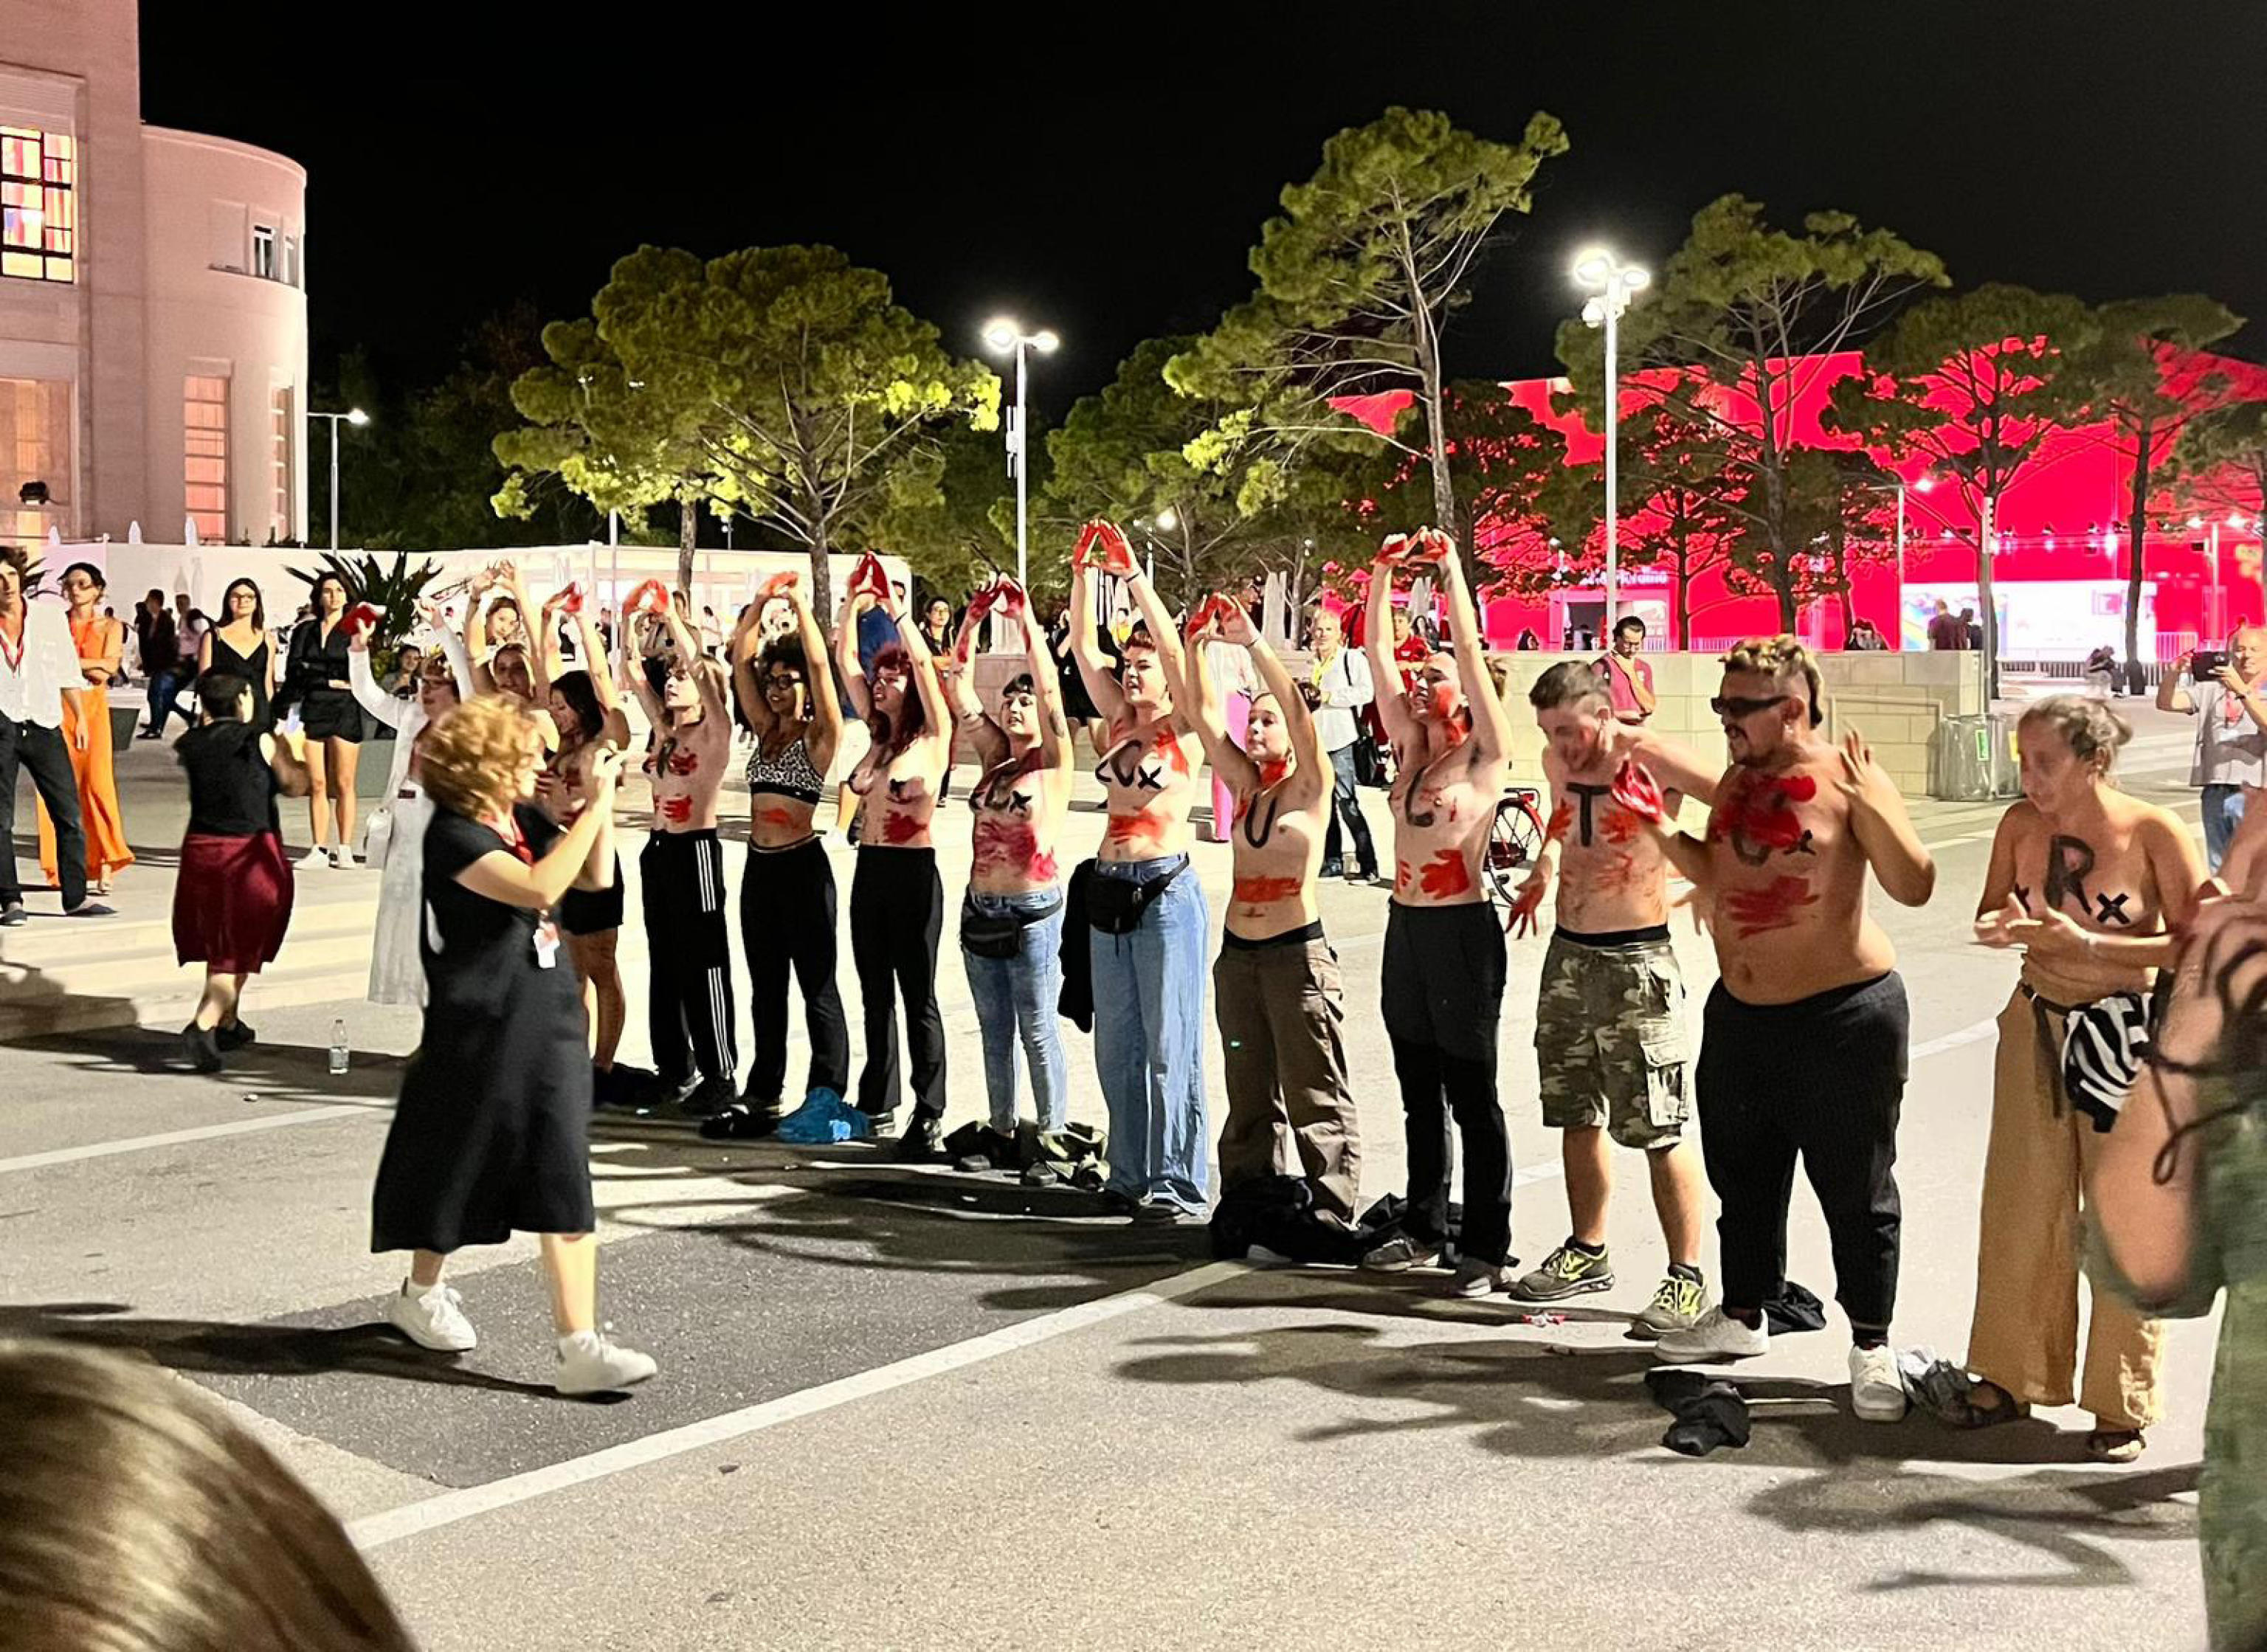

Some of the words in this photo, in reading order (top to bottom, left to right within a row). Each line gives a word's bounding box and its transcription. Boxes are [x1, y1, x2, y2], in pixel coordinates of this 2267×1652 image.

[1244, 792, 1278, 849] U
[1565, 782, 1612, 848] T
[2043, 834, 2095, 916] R
